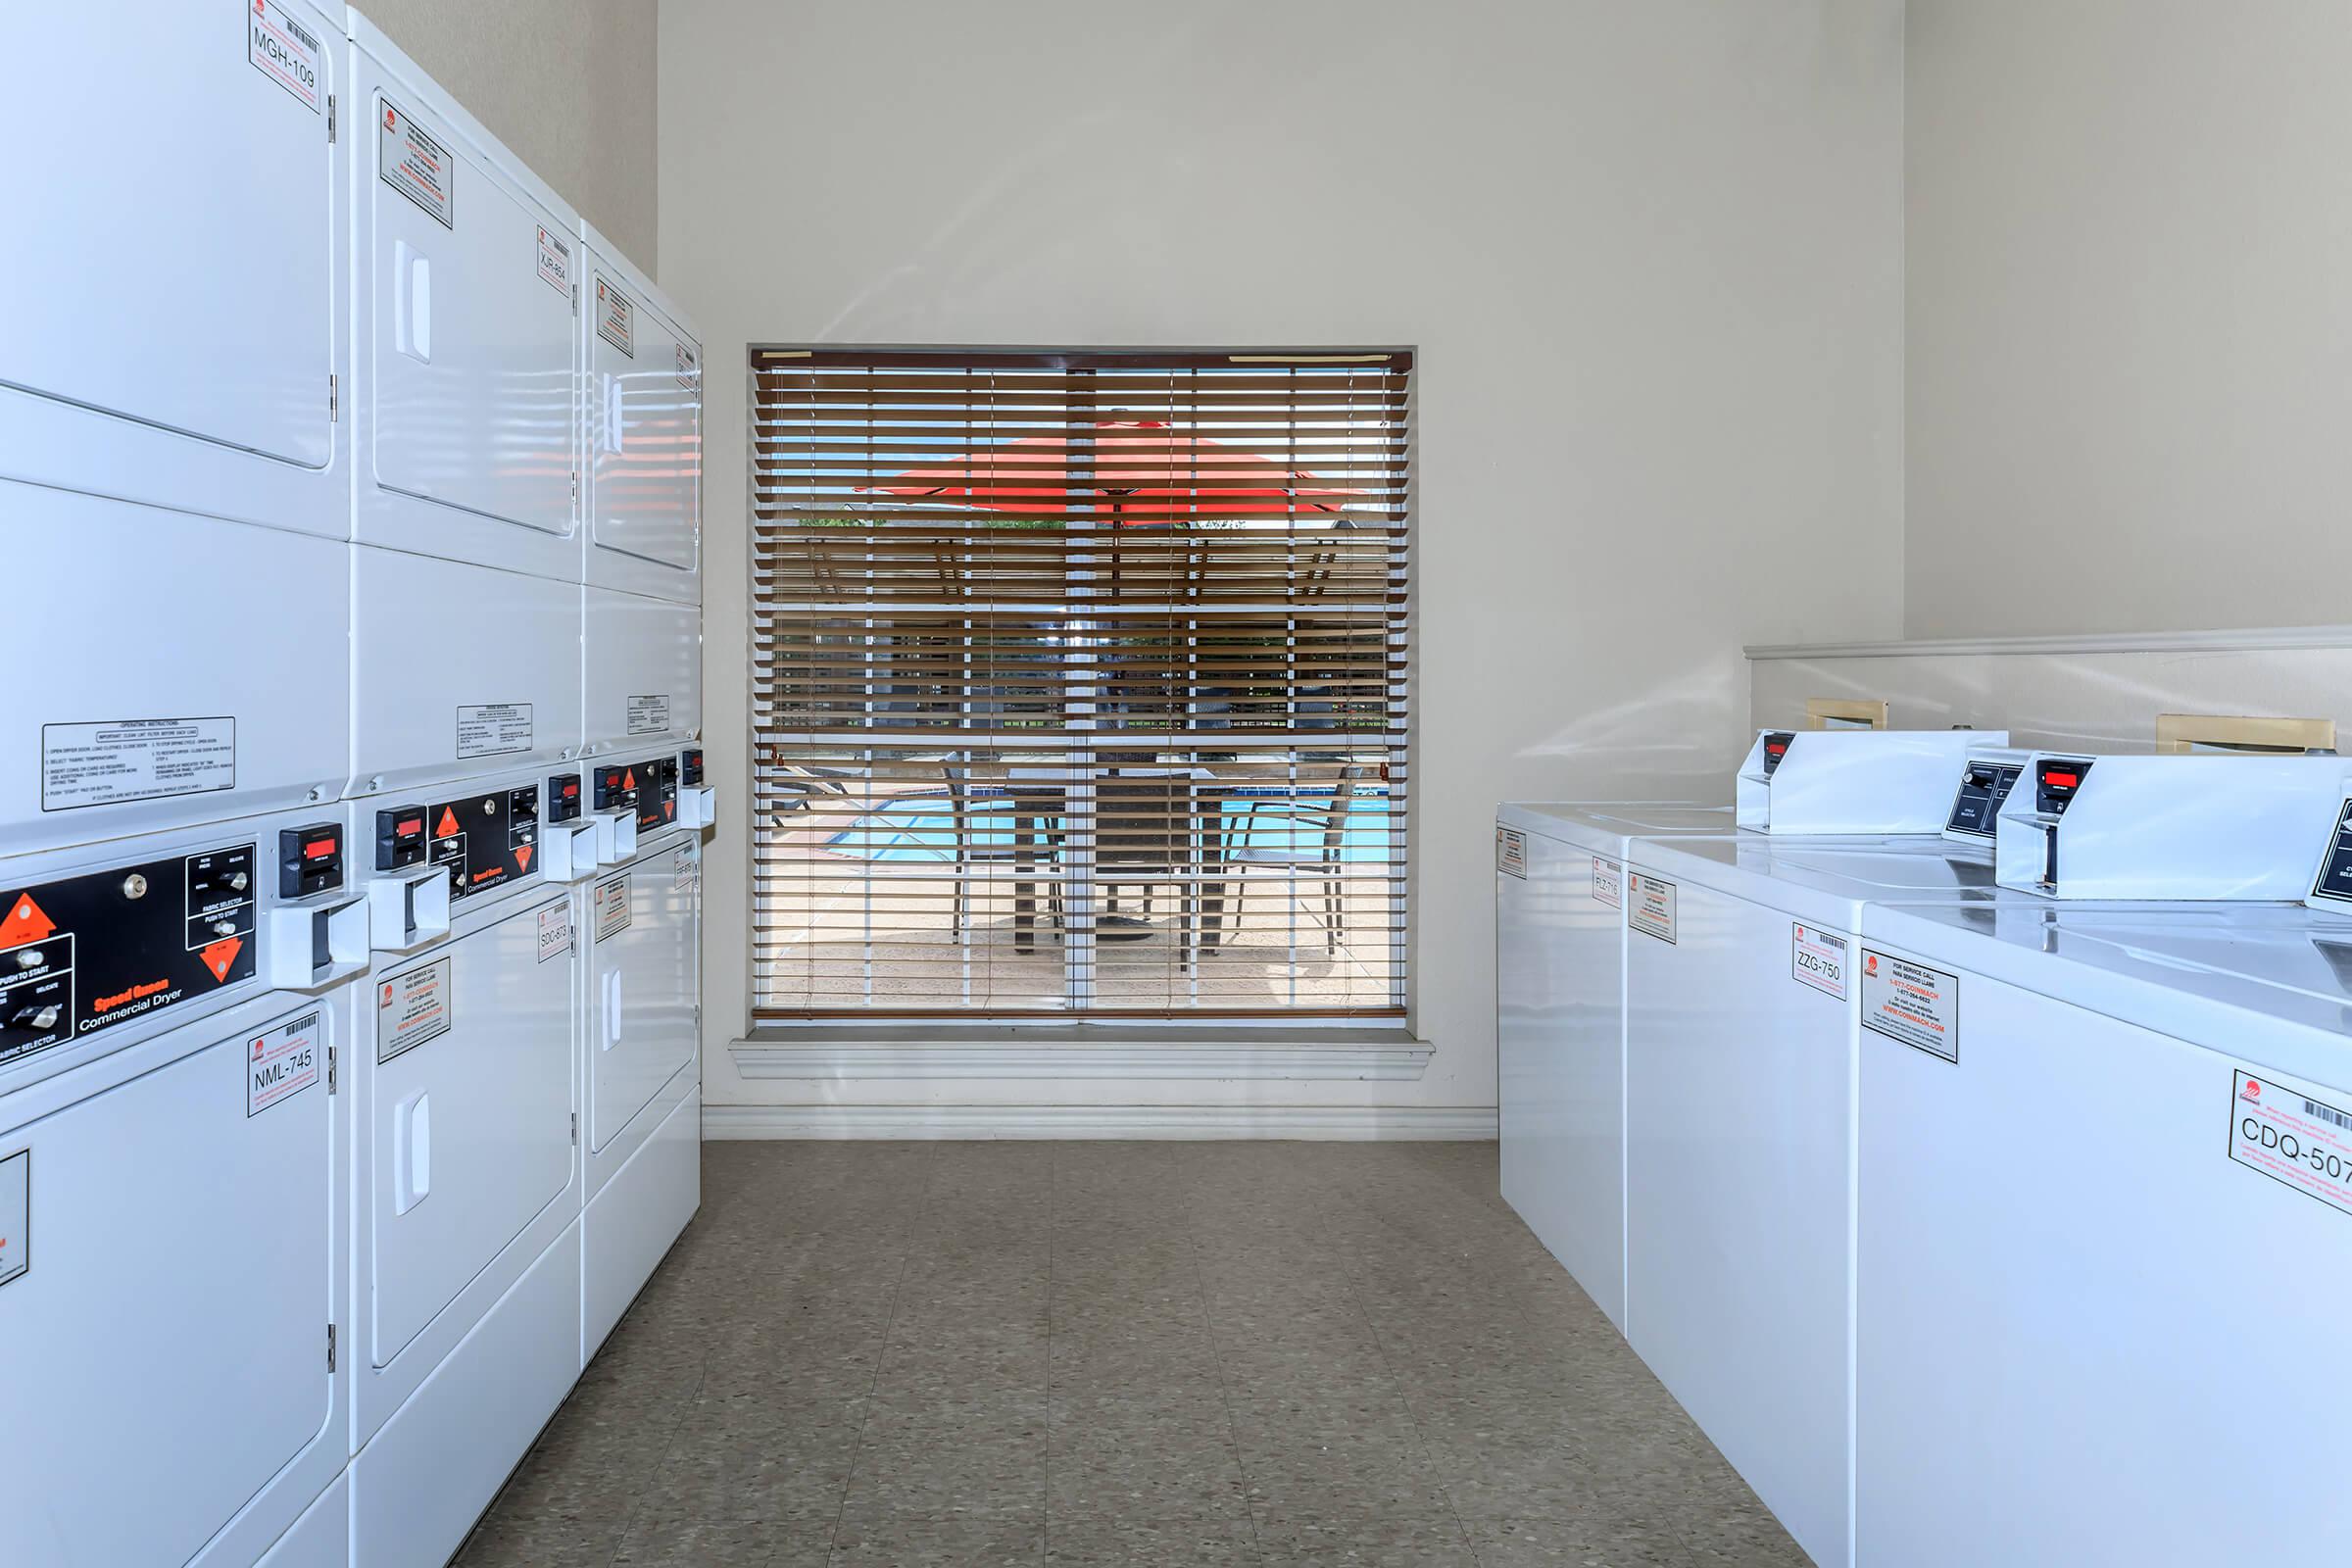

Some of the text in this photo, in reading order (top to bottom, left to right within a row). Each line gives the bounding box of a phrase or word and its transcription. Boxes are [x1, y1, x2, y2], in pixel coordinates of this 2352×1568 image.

[255, 26, 315, 88] MGH-109
[19, 970, 28, 981] TO
[29, 964, 50, 978] START
[1797, 951, 1840, 981] ZZG-750
[1892, 961, 1935, 980] FOR SERVICE CALL
[78, 987, 183, 1032] Commercial Dryer
[94, 978, 170, 1012] Speed Queen
[255, 1049, 313, 1092] NML-745
[2241, 1117, 2352, 1184] CDQ-507
